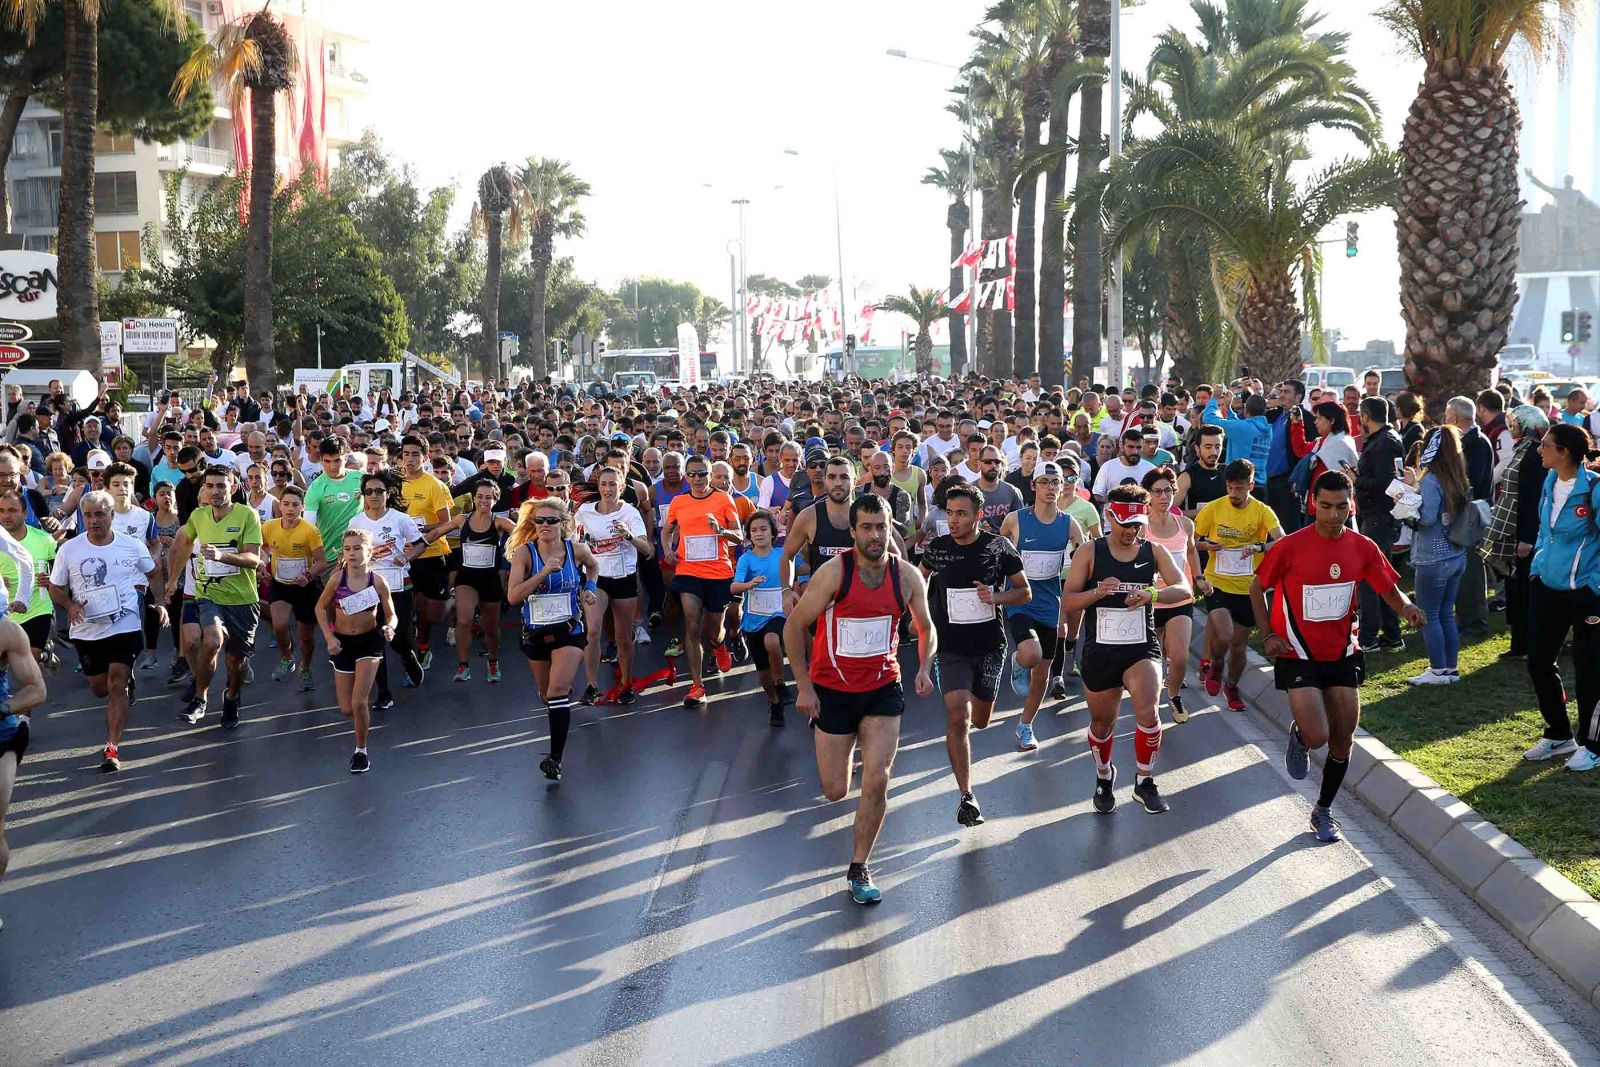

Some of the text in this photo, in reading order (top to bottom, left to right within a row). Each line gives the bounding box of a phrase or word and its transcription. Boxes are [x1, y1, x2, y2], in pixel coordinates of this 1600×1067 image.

[4, 351, 20, 359] TURU
[1104, 617, 1137, 637] F-66
[845, 630, 884, 646] D-120
